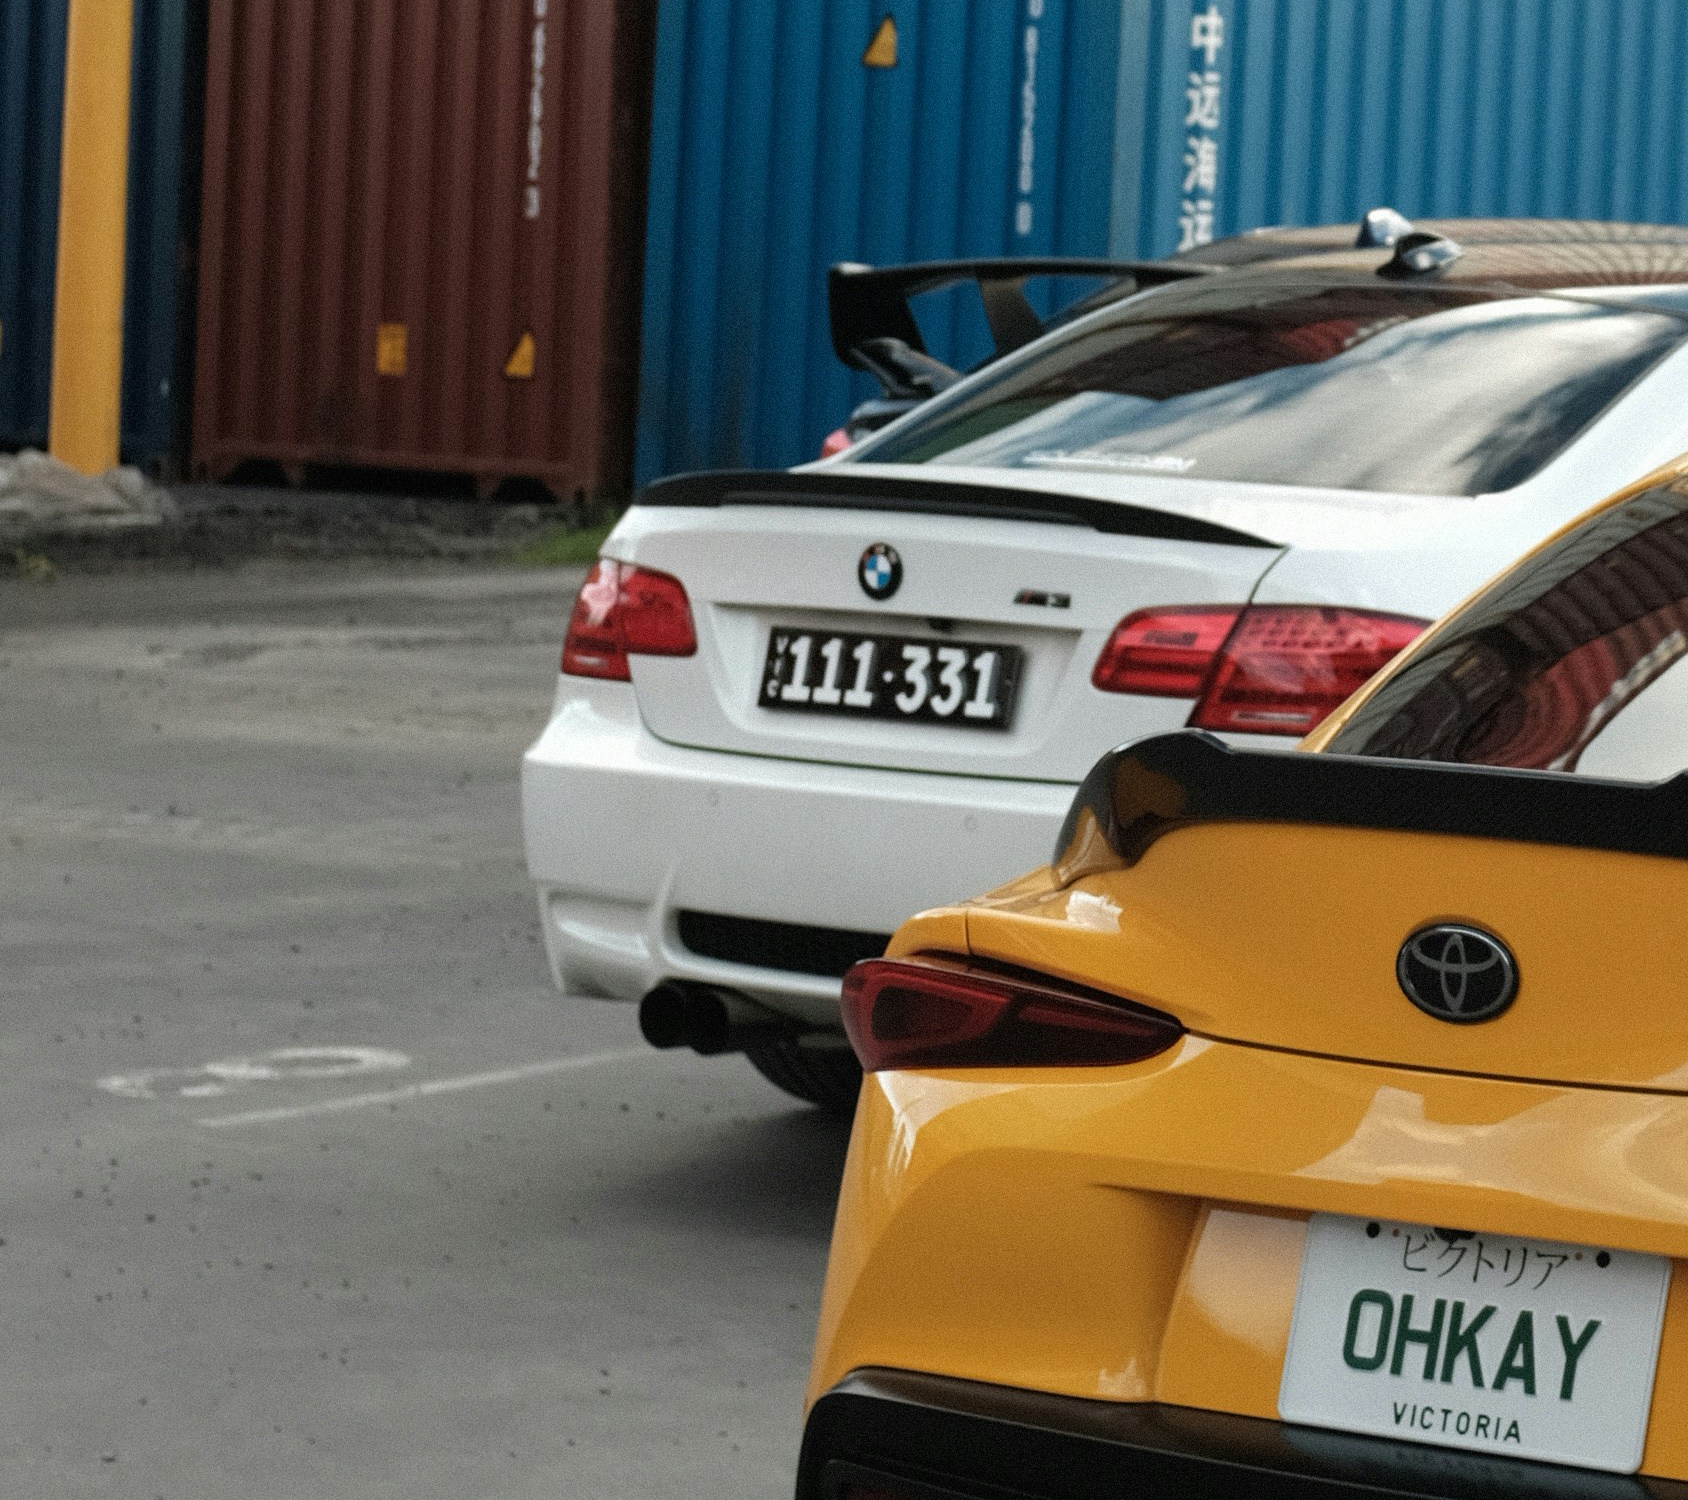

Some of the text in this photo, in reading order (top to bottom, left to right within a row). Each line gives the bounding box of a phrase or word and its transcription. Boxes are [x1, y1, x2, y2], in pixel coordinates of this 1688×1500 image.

[1403, 1233, 1568, 1289] ビクトリア
[1342, 1288, 1602, 1401] OHKAY
[1393, 1402, 1521, 1444] VICTORIA
